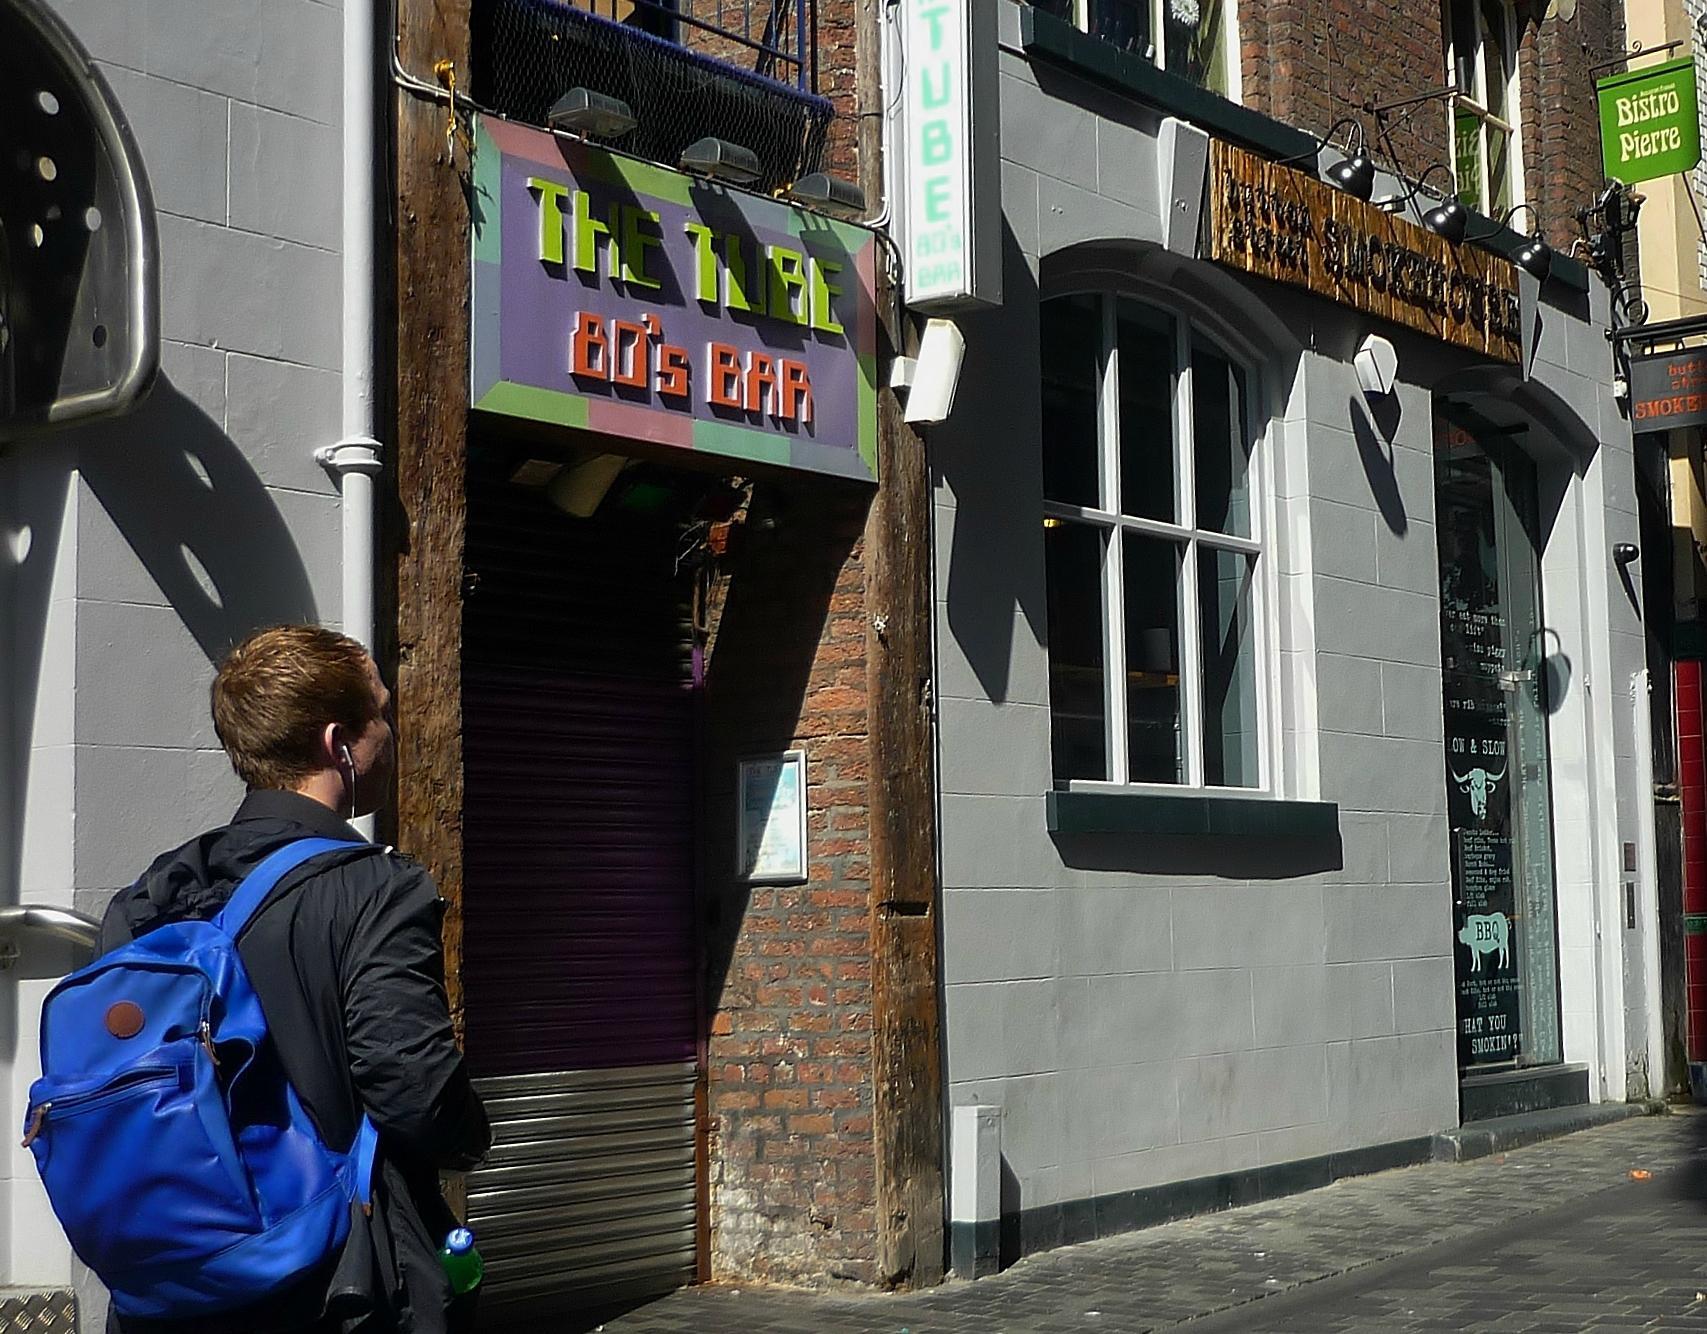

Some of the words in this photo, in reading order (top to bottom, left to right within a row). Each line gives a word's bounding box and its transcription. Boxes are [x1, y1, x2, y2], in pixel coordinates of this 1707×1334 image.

[918, 6, 952, 223] TUBE
[1615, 90, 1680, 127] Bistro
[1619, 126, 1681, 162] Pierre
[526, 176, 662, 289] THE
[684, 221, 844, 335] TUBE
[916, 261, 961, 288] BAR
[568, 311, 689, 397] 80's
[706, 341, 812, 423] BAR
[1452, 737, 1465, 753] OW
[1470, 738, 1478, 754] &
[1482, 739, 1506, 756] SLOW
[1475, 921, 1500, 943] BBQ
[1463, 1016, 1483, 1034] HAT
[1487, 1014, 1508, 1032] YOU
